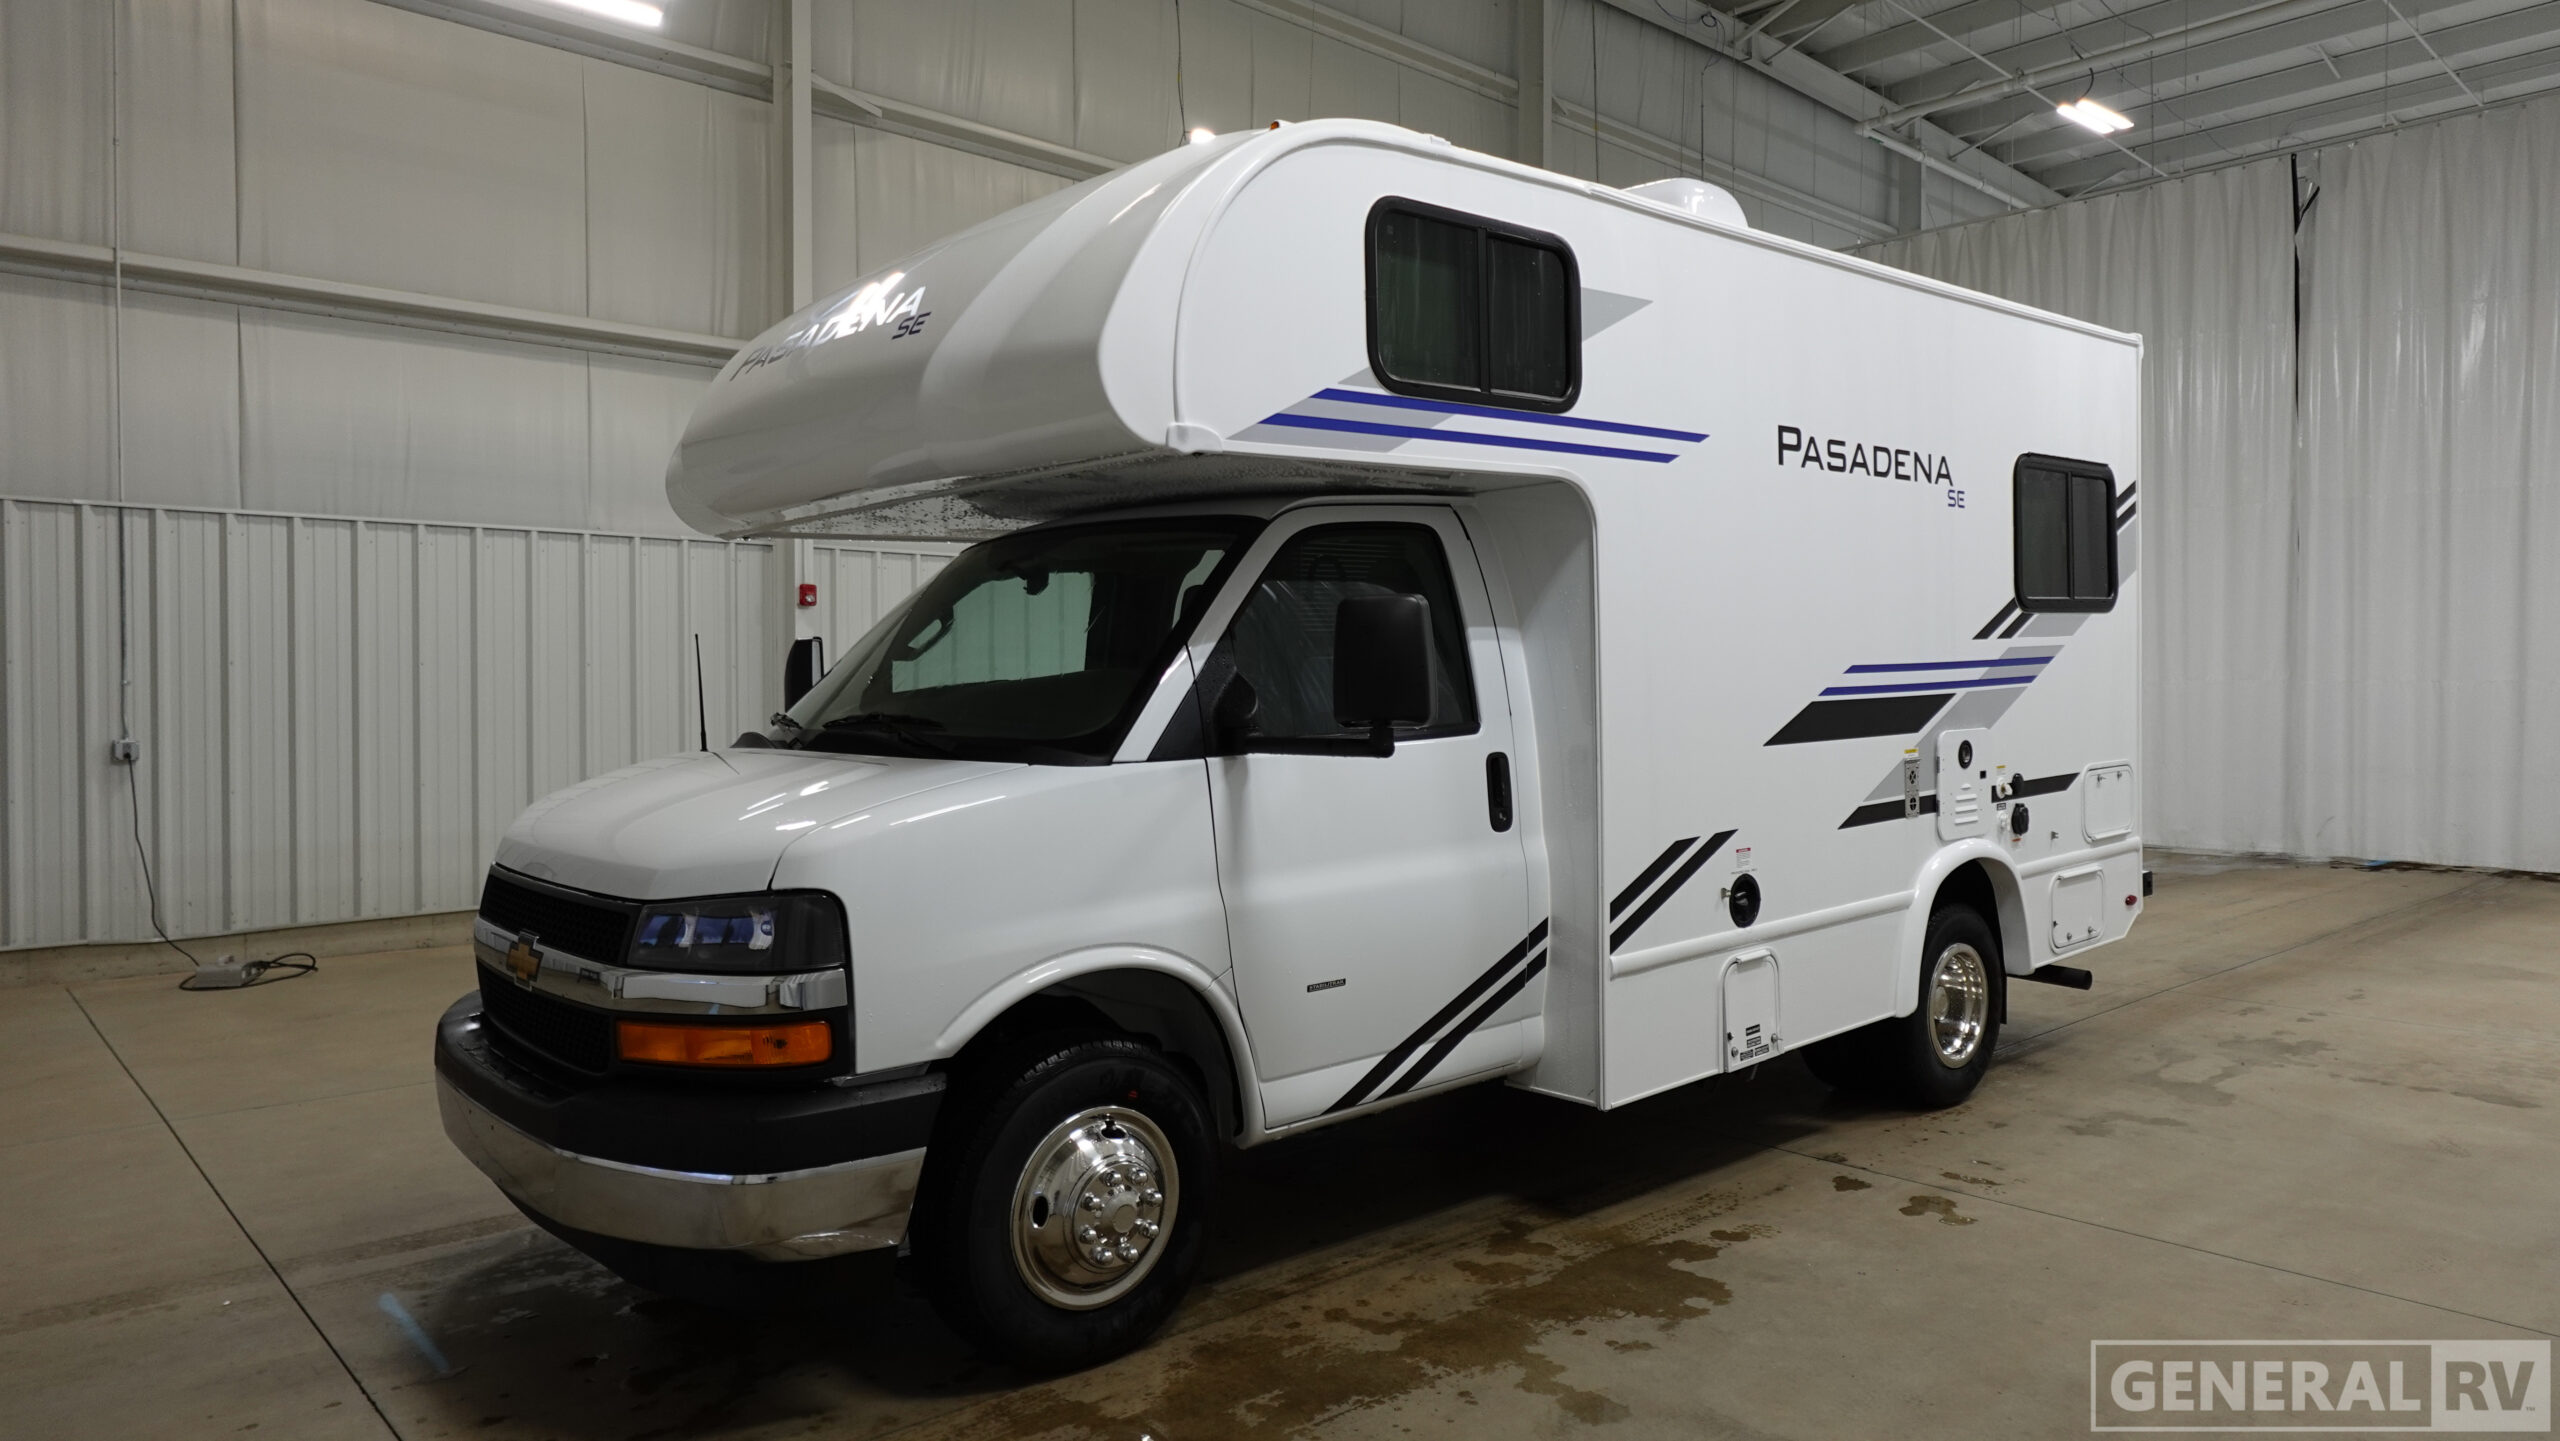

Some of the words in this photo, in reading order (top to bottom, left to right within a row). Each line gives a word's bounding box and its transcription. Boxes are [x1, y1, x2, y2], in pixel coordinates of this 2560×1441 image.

[730, 286, 926, 381] PASADENA
[891, 311, 932, 340] SE
[1777, 424, 1954, 487] PASADENA
[1947, 489, 1966, 509] SE
